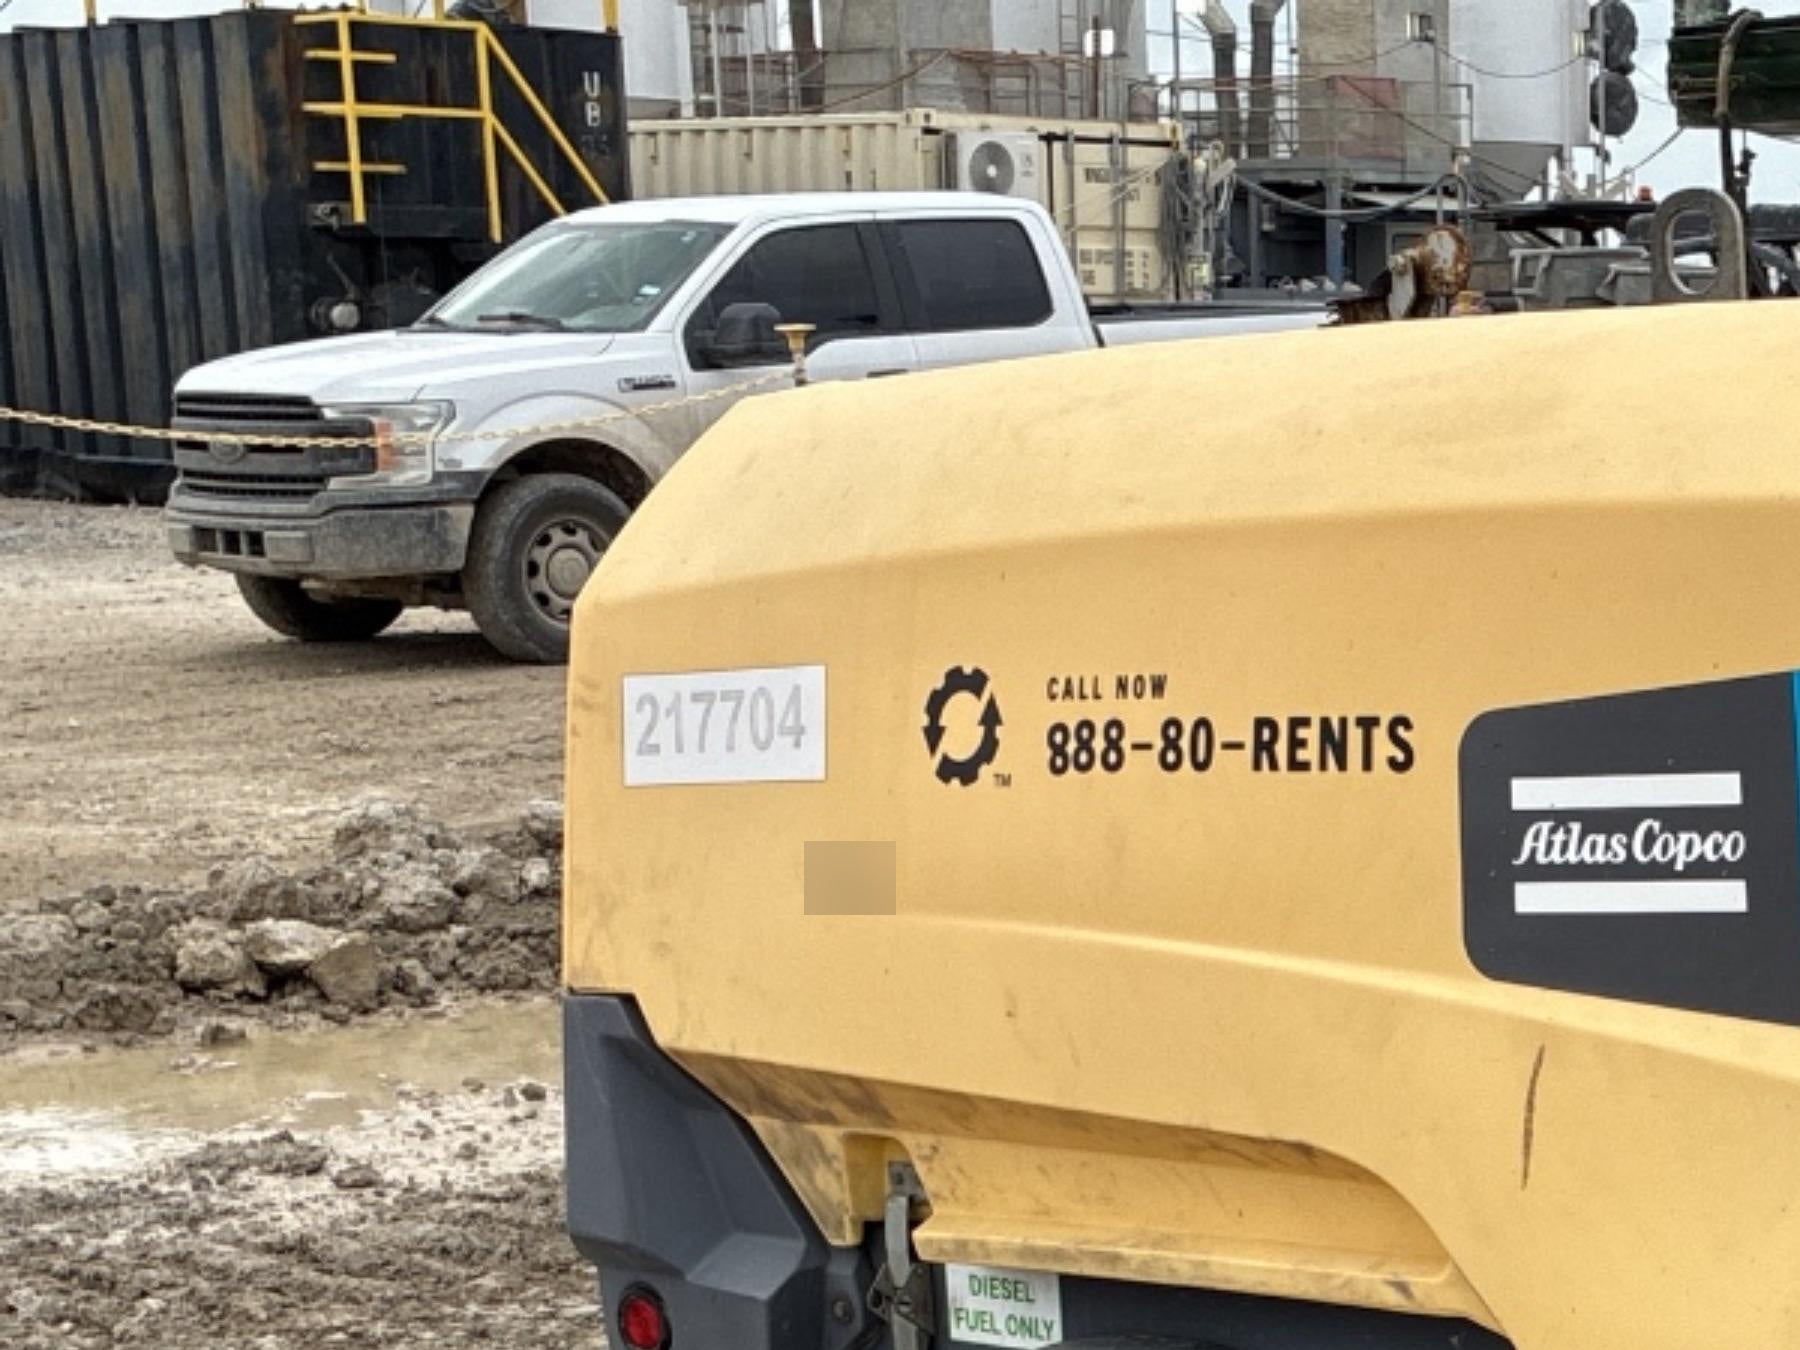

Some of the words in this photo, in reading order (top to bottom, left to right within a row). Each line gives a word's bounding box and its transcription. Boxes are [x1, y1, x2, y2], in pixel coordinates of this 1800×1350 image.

[1046, 676, 1103, 700] CALL
[1115, 673, 1169, 699] NOW
[635, 683, 806, 757] 217704
[1046, 714, 1416, 776] 888-80-RENTS
[1512, 820, 1627, 865] Atlas
[1631, 817, 1746, 871] Copco
[968, 1273, 1036, 1305] DIESEL
[953, 1306, 1003, 1336] FUEL
[1004, 1312, 1056, 1342] ONLY
